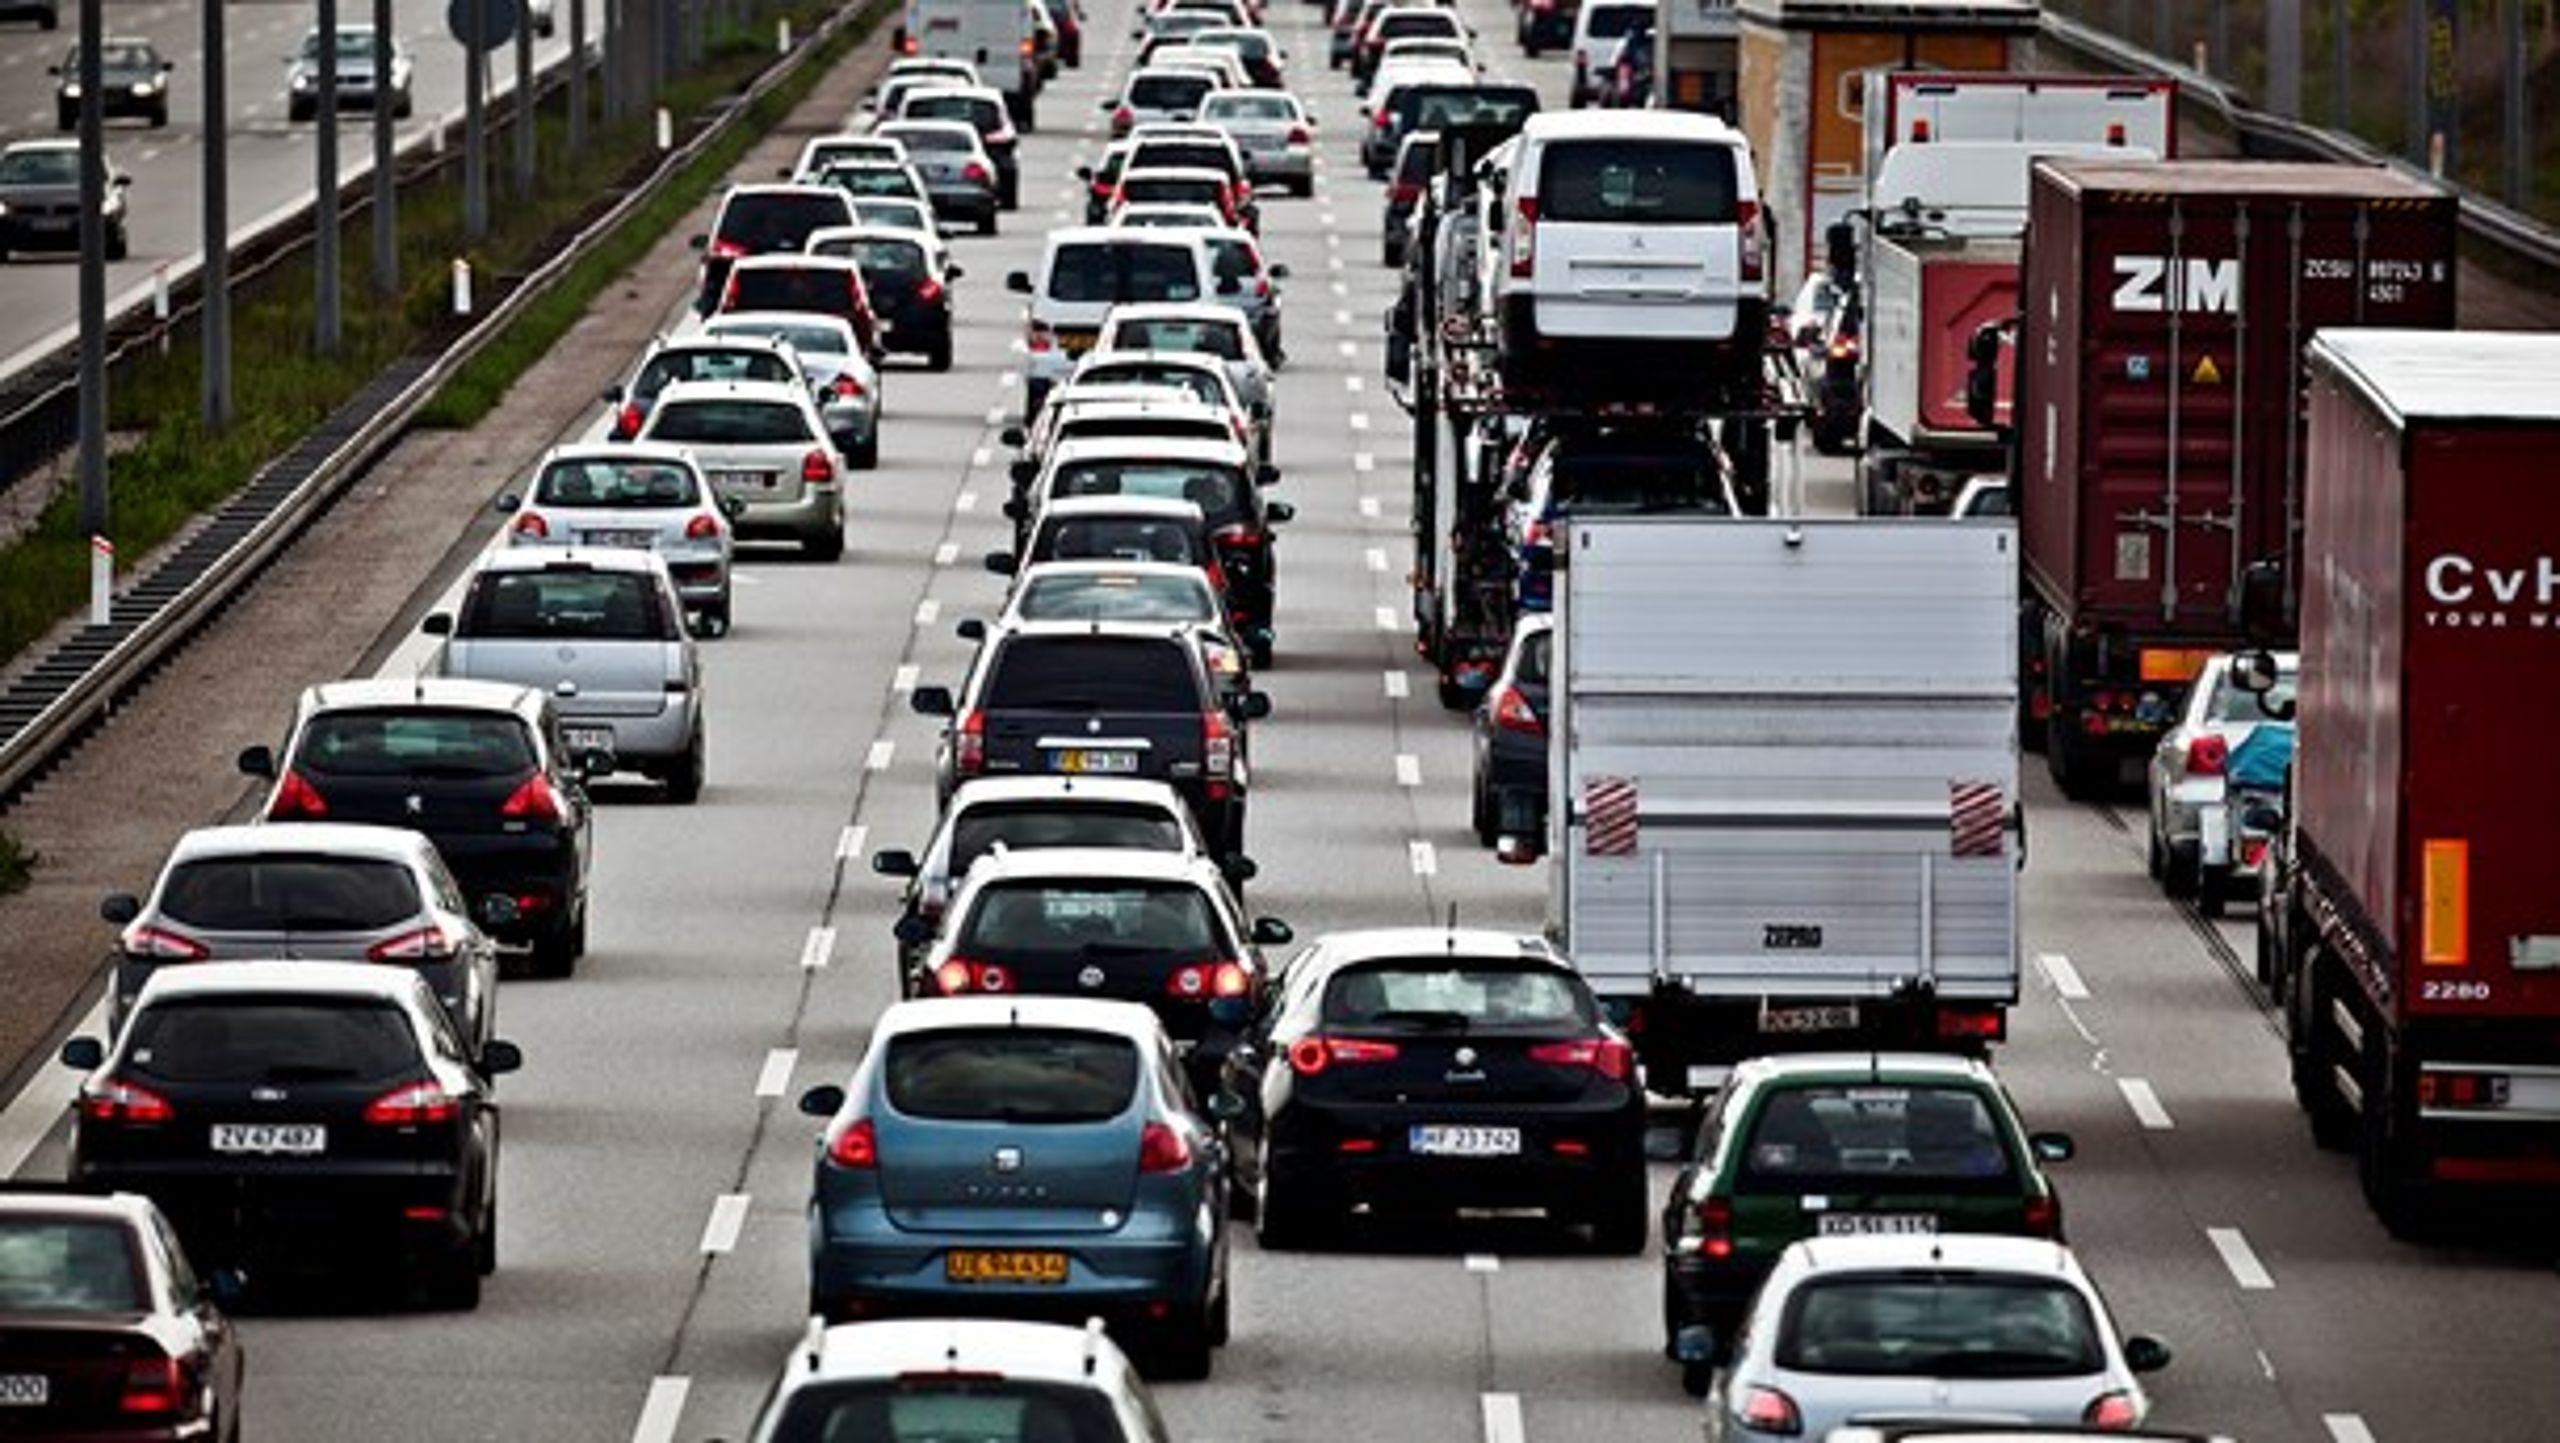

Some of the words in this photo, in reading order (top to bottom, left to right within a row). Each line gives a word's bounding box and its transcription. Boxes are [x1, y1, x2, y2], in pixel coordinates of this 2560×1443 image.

[2304, 258, 2352, 278] ZCSU
[2113, 255, 2239, 313] ZIM
[2425, 612, 2507, 627] YOUR
